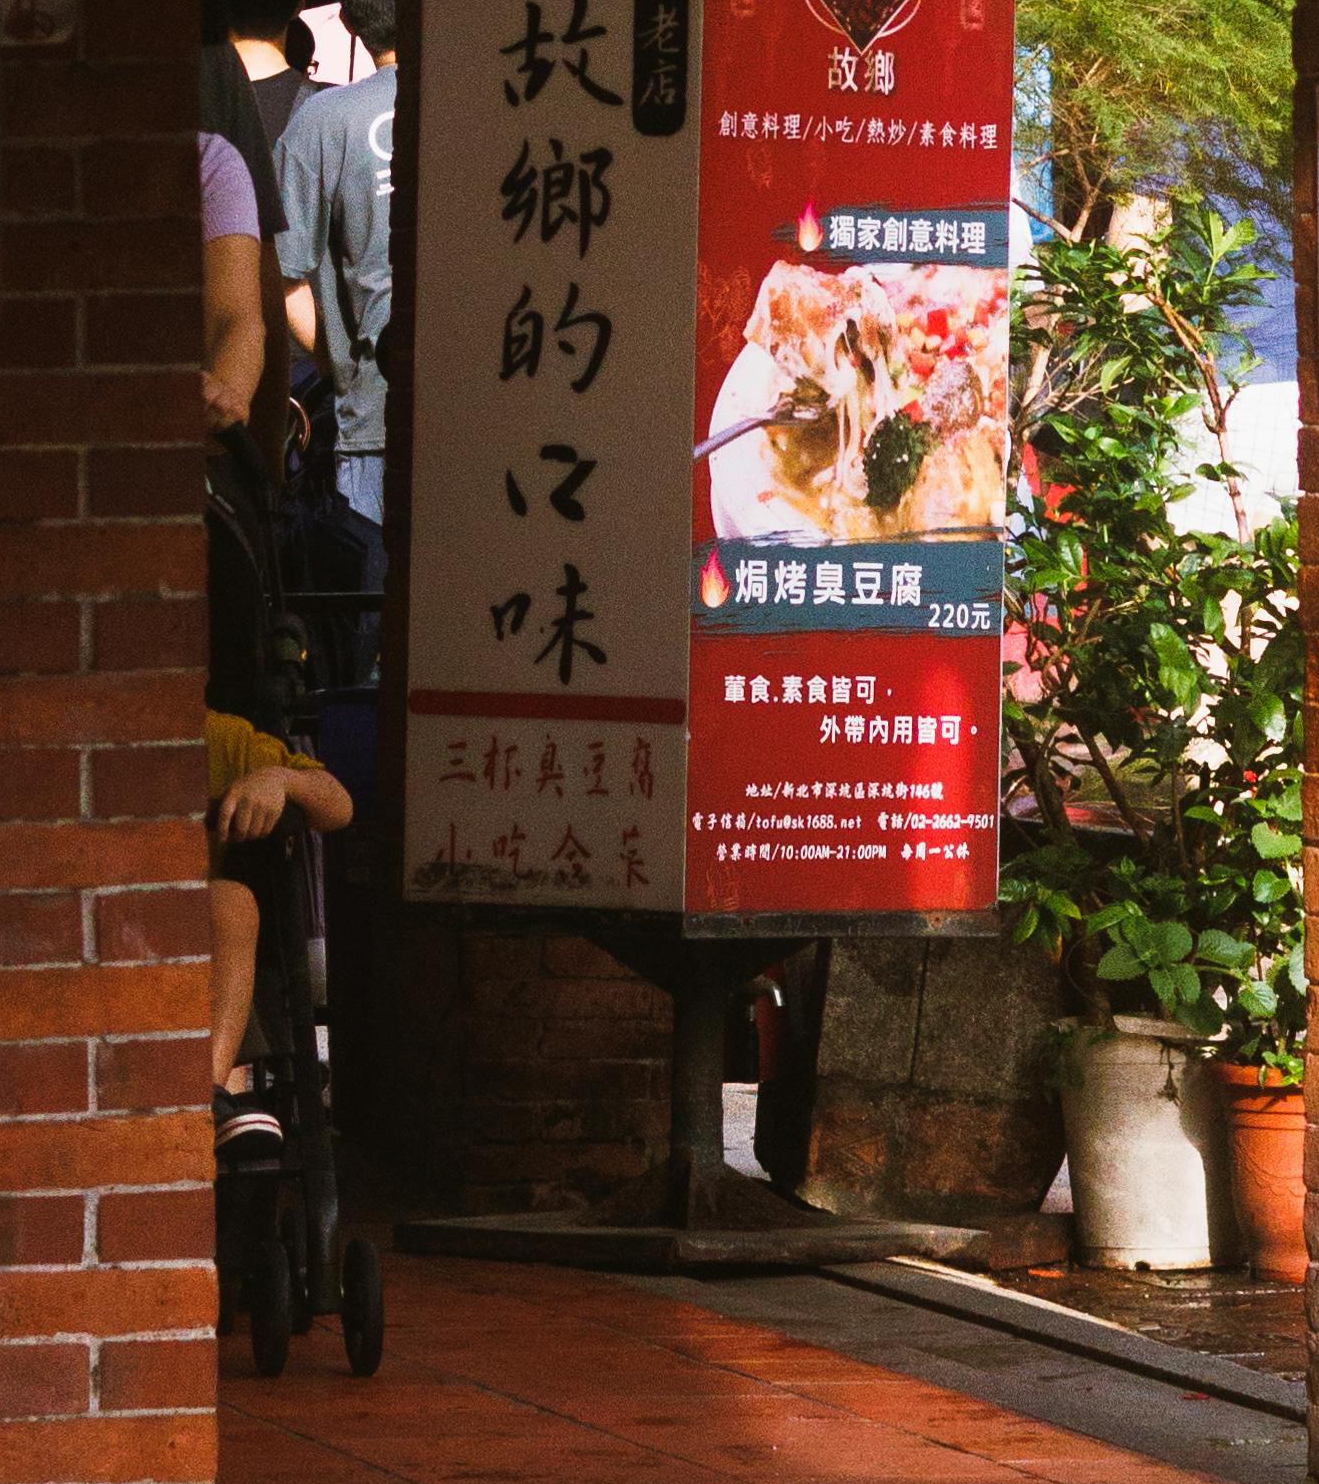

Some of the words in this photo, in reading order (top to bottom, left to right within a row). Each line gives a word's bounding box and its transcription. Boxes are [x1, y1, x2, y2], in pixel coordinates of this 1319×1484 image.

[828, 46, 895, 96] 故鄉
[718, 110, 998, 150] 創意料理/小吃/熱炒/素食料理
[829, 216, 986, 255] 獨家創意料理
[735, 559, 922, 607] 焗烤臭豆腐
[928, 603, 991, 629] 220元
[439, 733, 653, 800] 三杯臭豆腐
[692, 812, 862, 831] 電子信箱/tofu@sk1688.net
[877, 811, 994, 831] 電話/02-2662-9501
[716, 842, 887, 862] 營業時間/10:00AM-21:00PM
